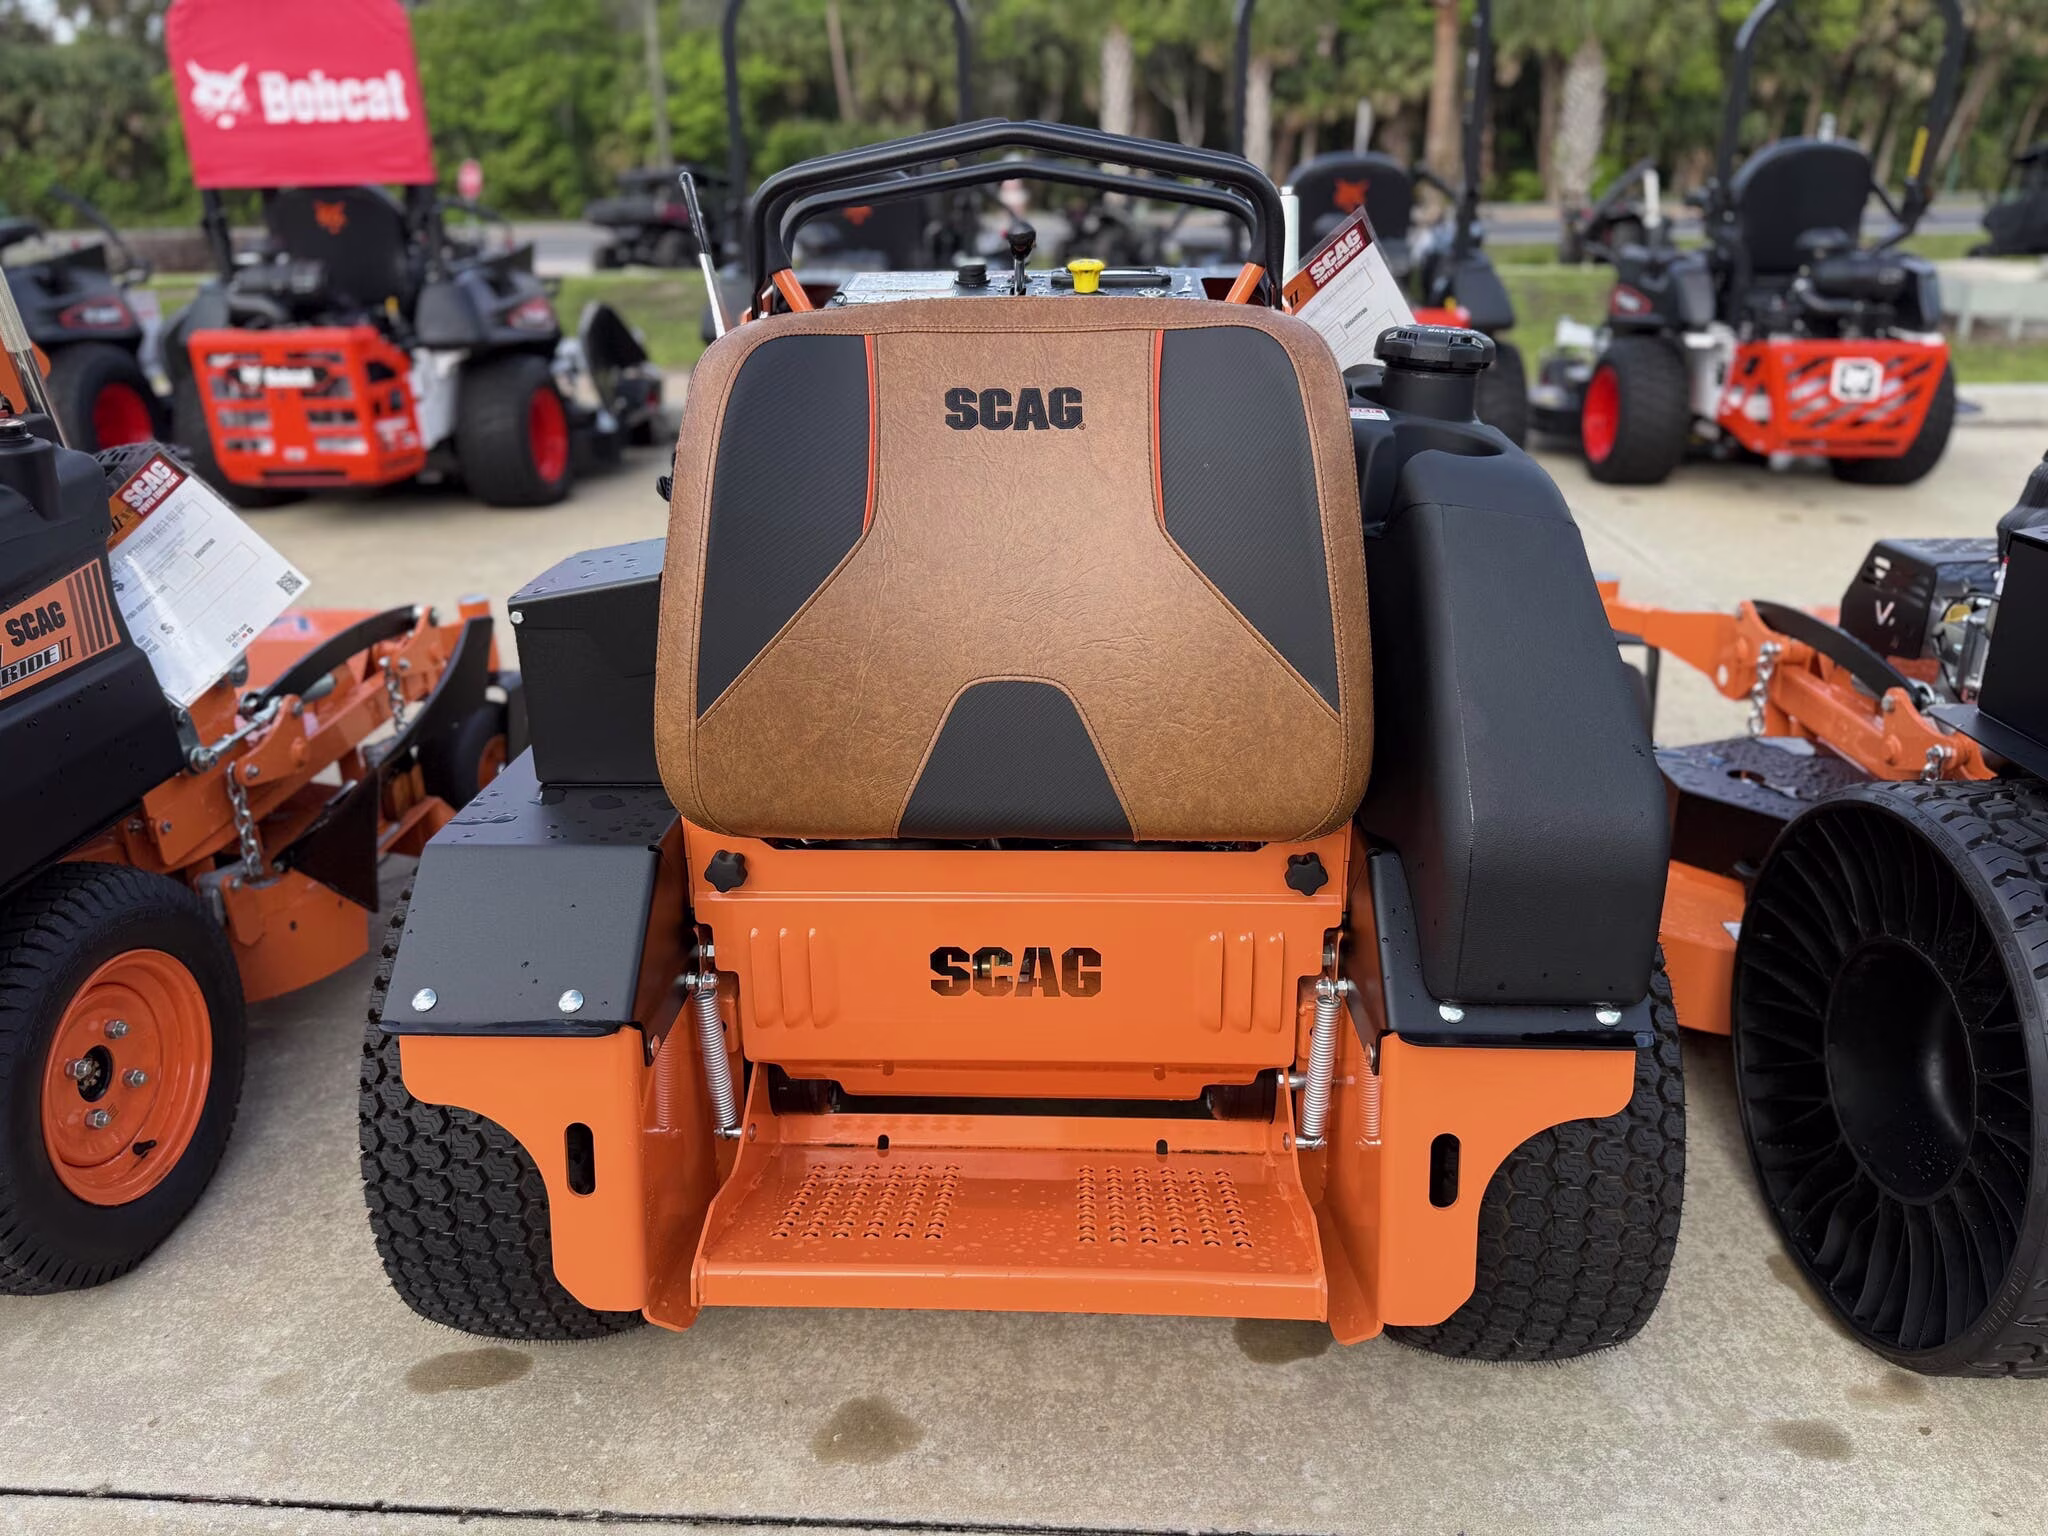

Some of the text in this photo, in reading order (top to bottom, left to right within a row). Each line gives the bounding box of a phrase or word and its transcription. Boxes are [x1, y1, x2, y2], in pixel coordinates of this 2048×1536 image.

[257, 69, 410, 124] Bobcat
[1310, 229, 1361, 280] SCAG
[945, 387, 1083, 430] SCAG
[122, 461, 171, 509] SCAG
[5, 601, 66, 647] SCAG
[930, 947, 1101, 997] SCAG
